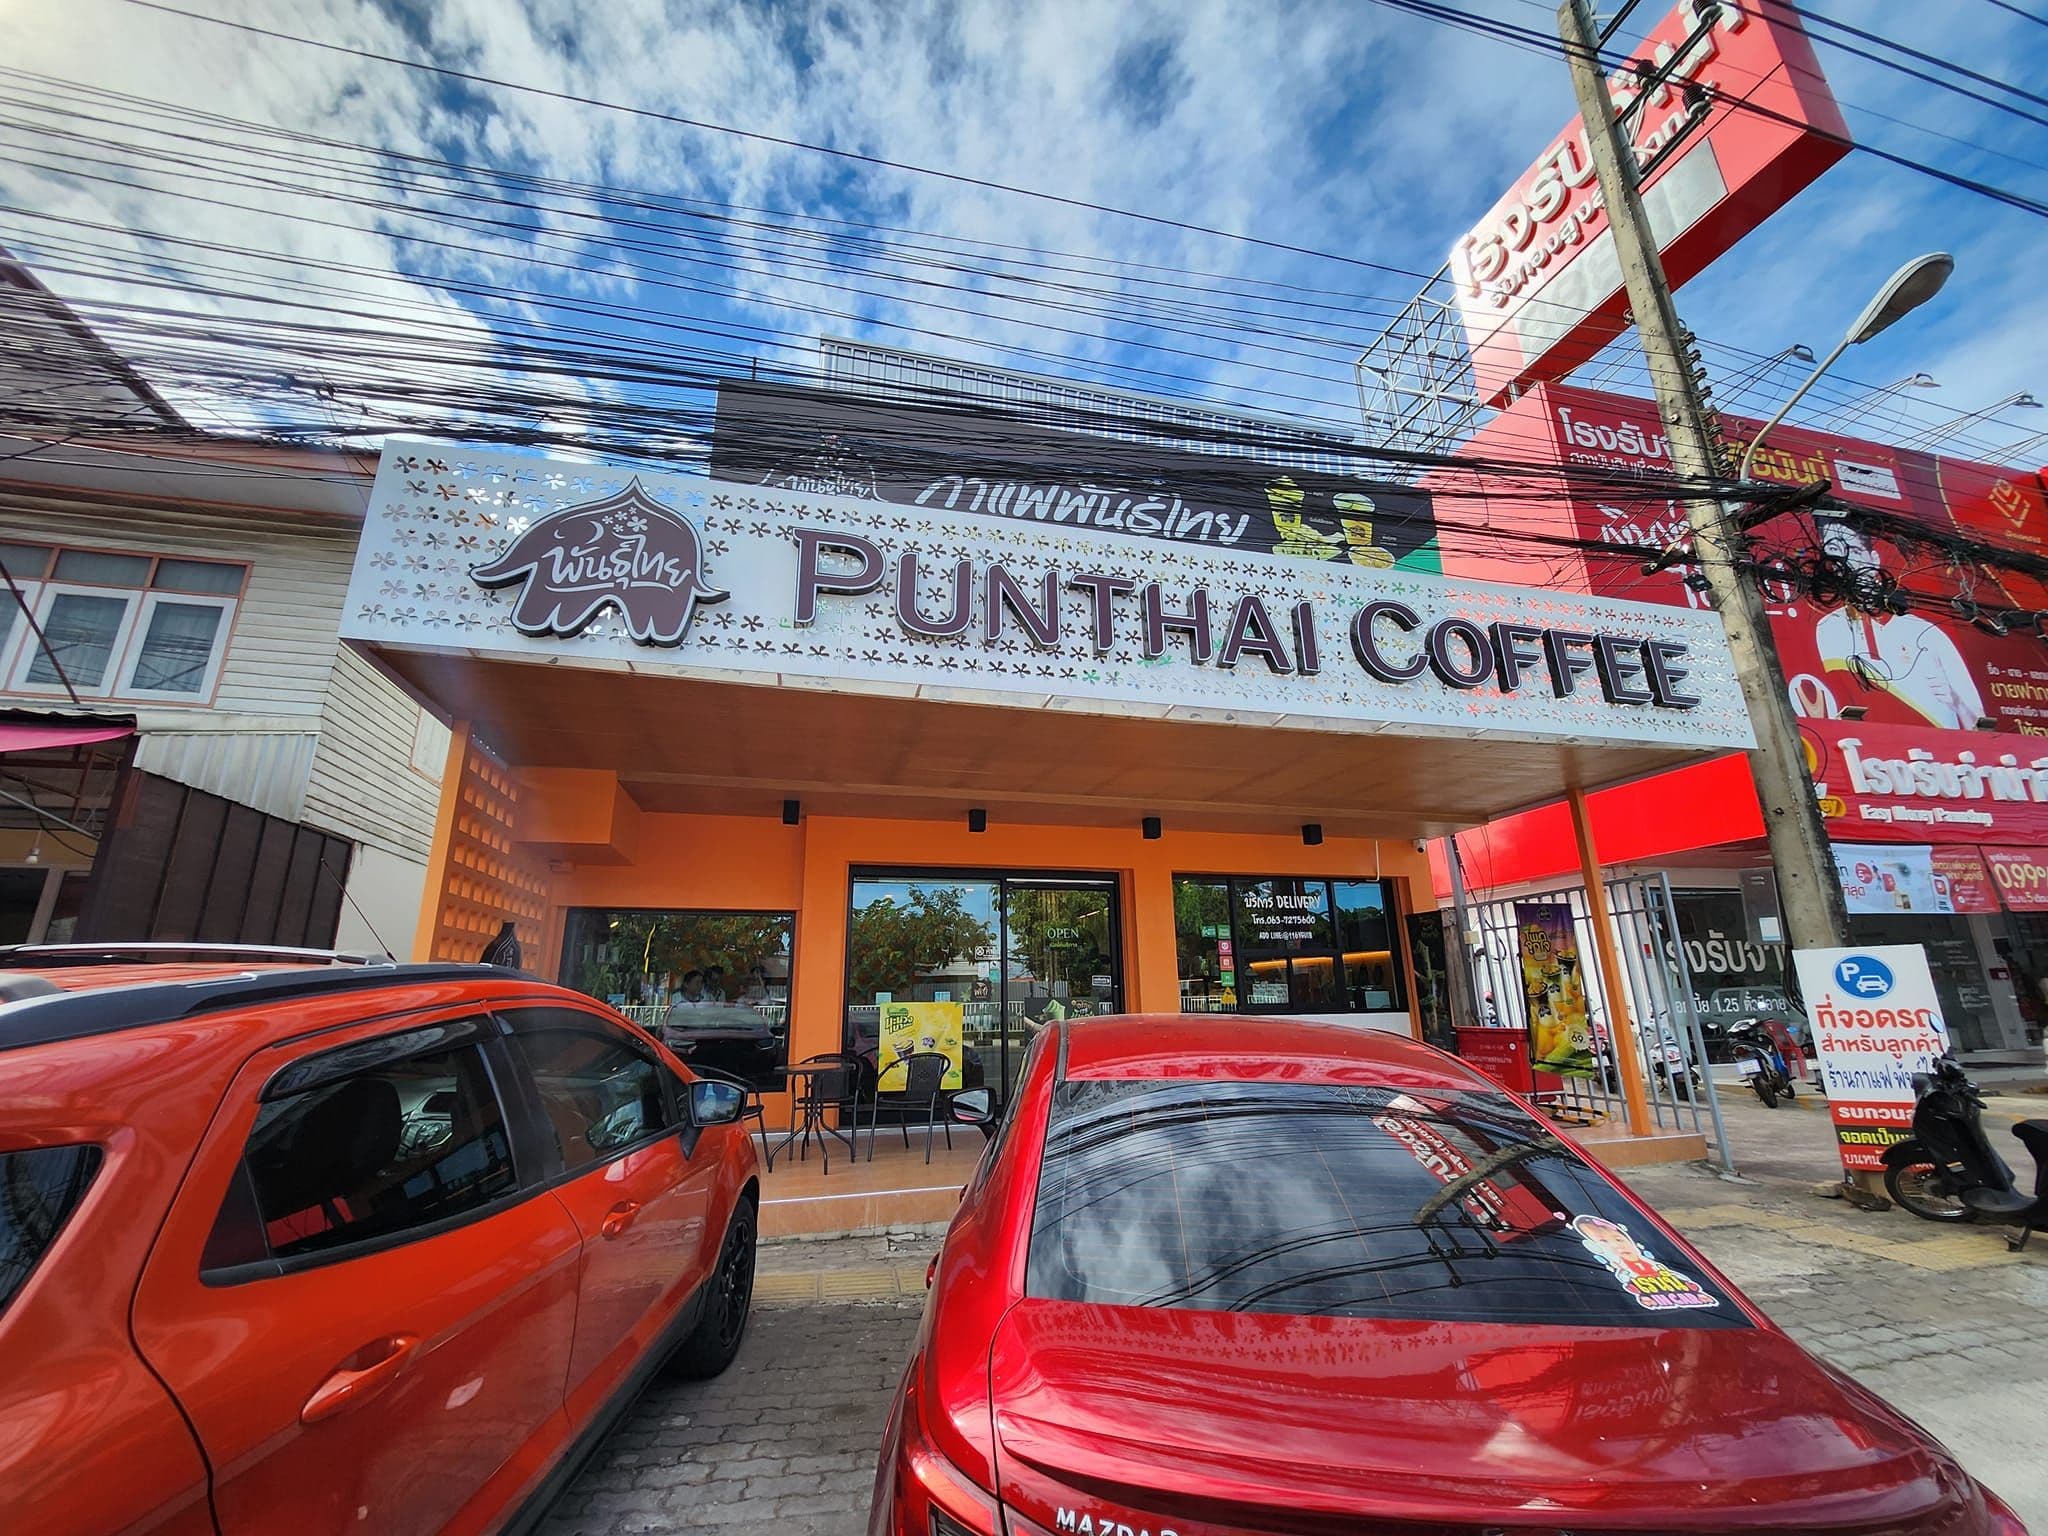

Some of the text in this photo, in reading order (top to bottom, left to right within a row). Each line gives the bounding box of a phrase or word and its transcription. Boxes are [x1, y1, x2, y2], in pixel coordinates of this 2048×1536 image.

[791, 526, 1702, 711] PUNTHAI COFFEE
[1275, 895, 1321, 909] DELIVERY
[1047, 927, 1079, 939] OPEN
[1714, 998, 1740, 1012] 1.25
[1822, 1033, 1943, 1059] สำหรับลูกค้า
